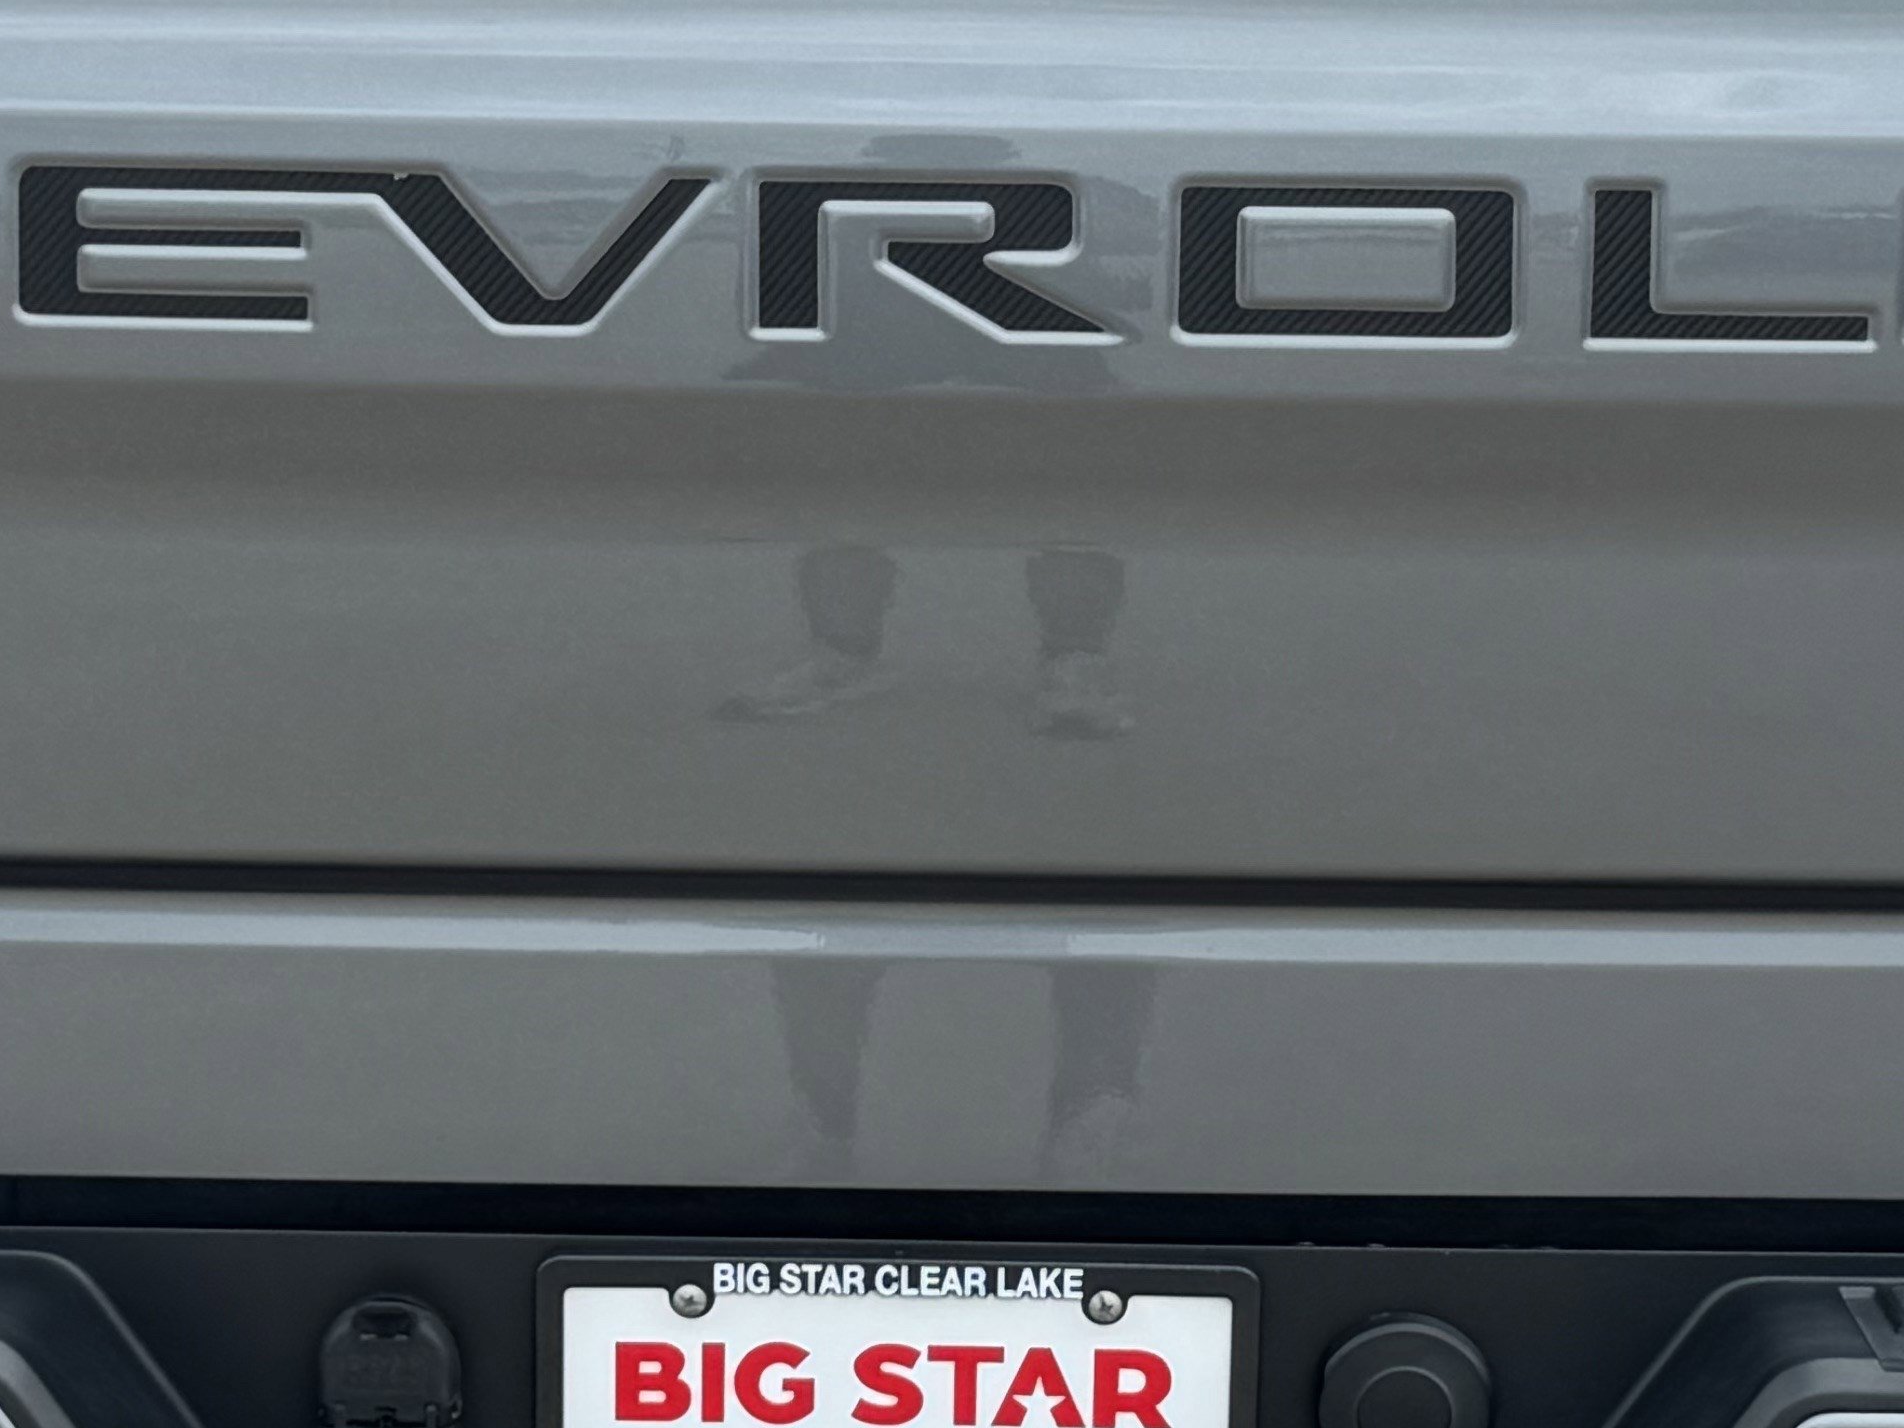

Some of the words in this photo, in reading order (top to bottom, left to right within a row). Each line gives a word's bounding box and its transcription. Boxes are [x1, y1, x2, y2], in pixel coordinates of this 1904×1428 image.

[712, 1262, 771, 1294] BIG
[779, 1263, 866, 1296] STAR
[874, 1264, 987, 1298] CLEAR
[996, 1267, 1084, 1300] LAKE
[615, 1342, 815, 1426] BIG
